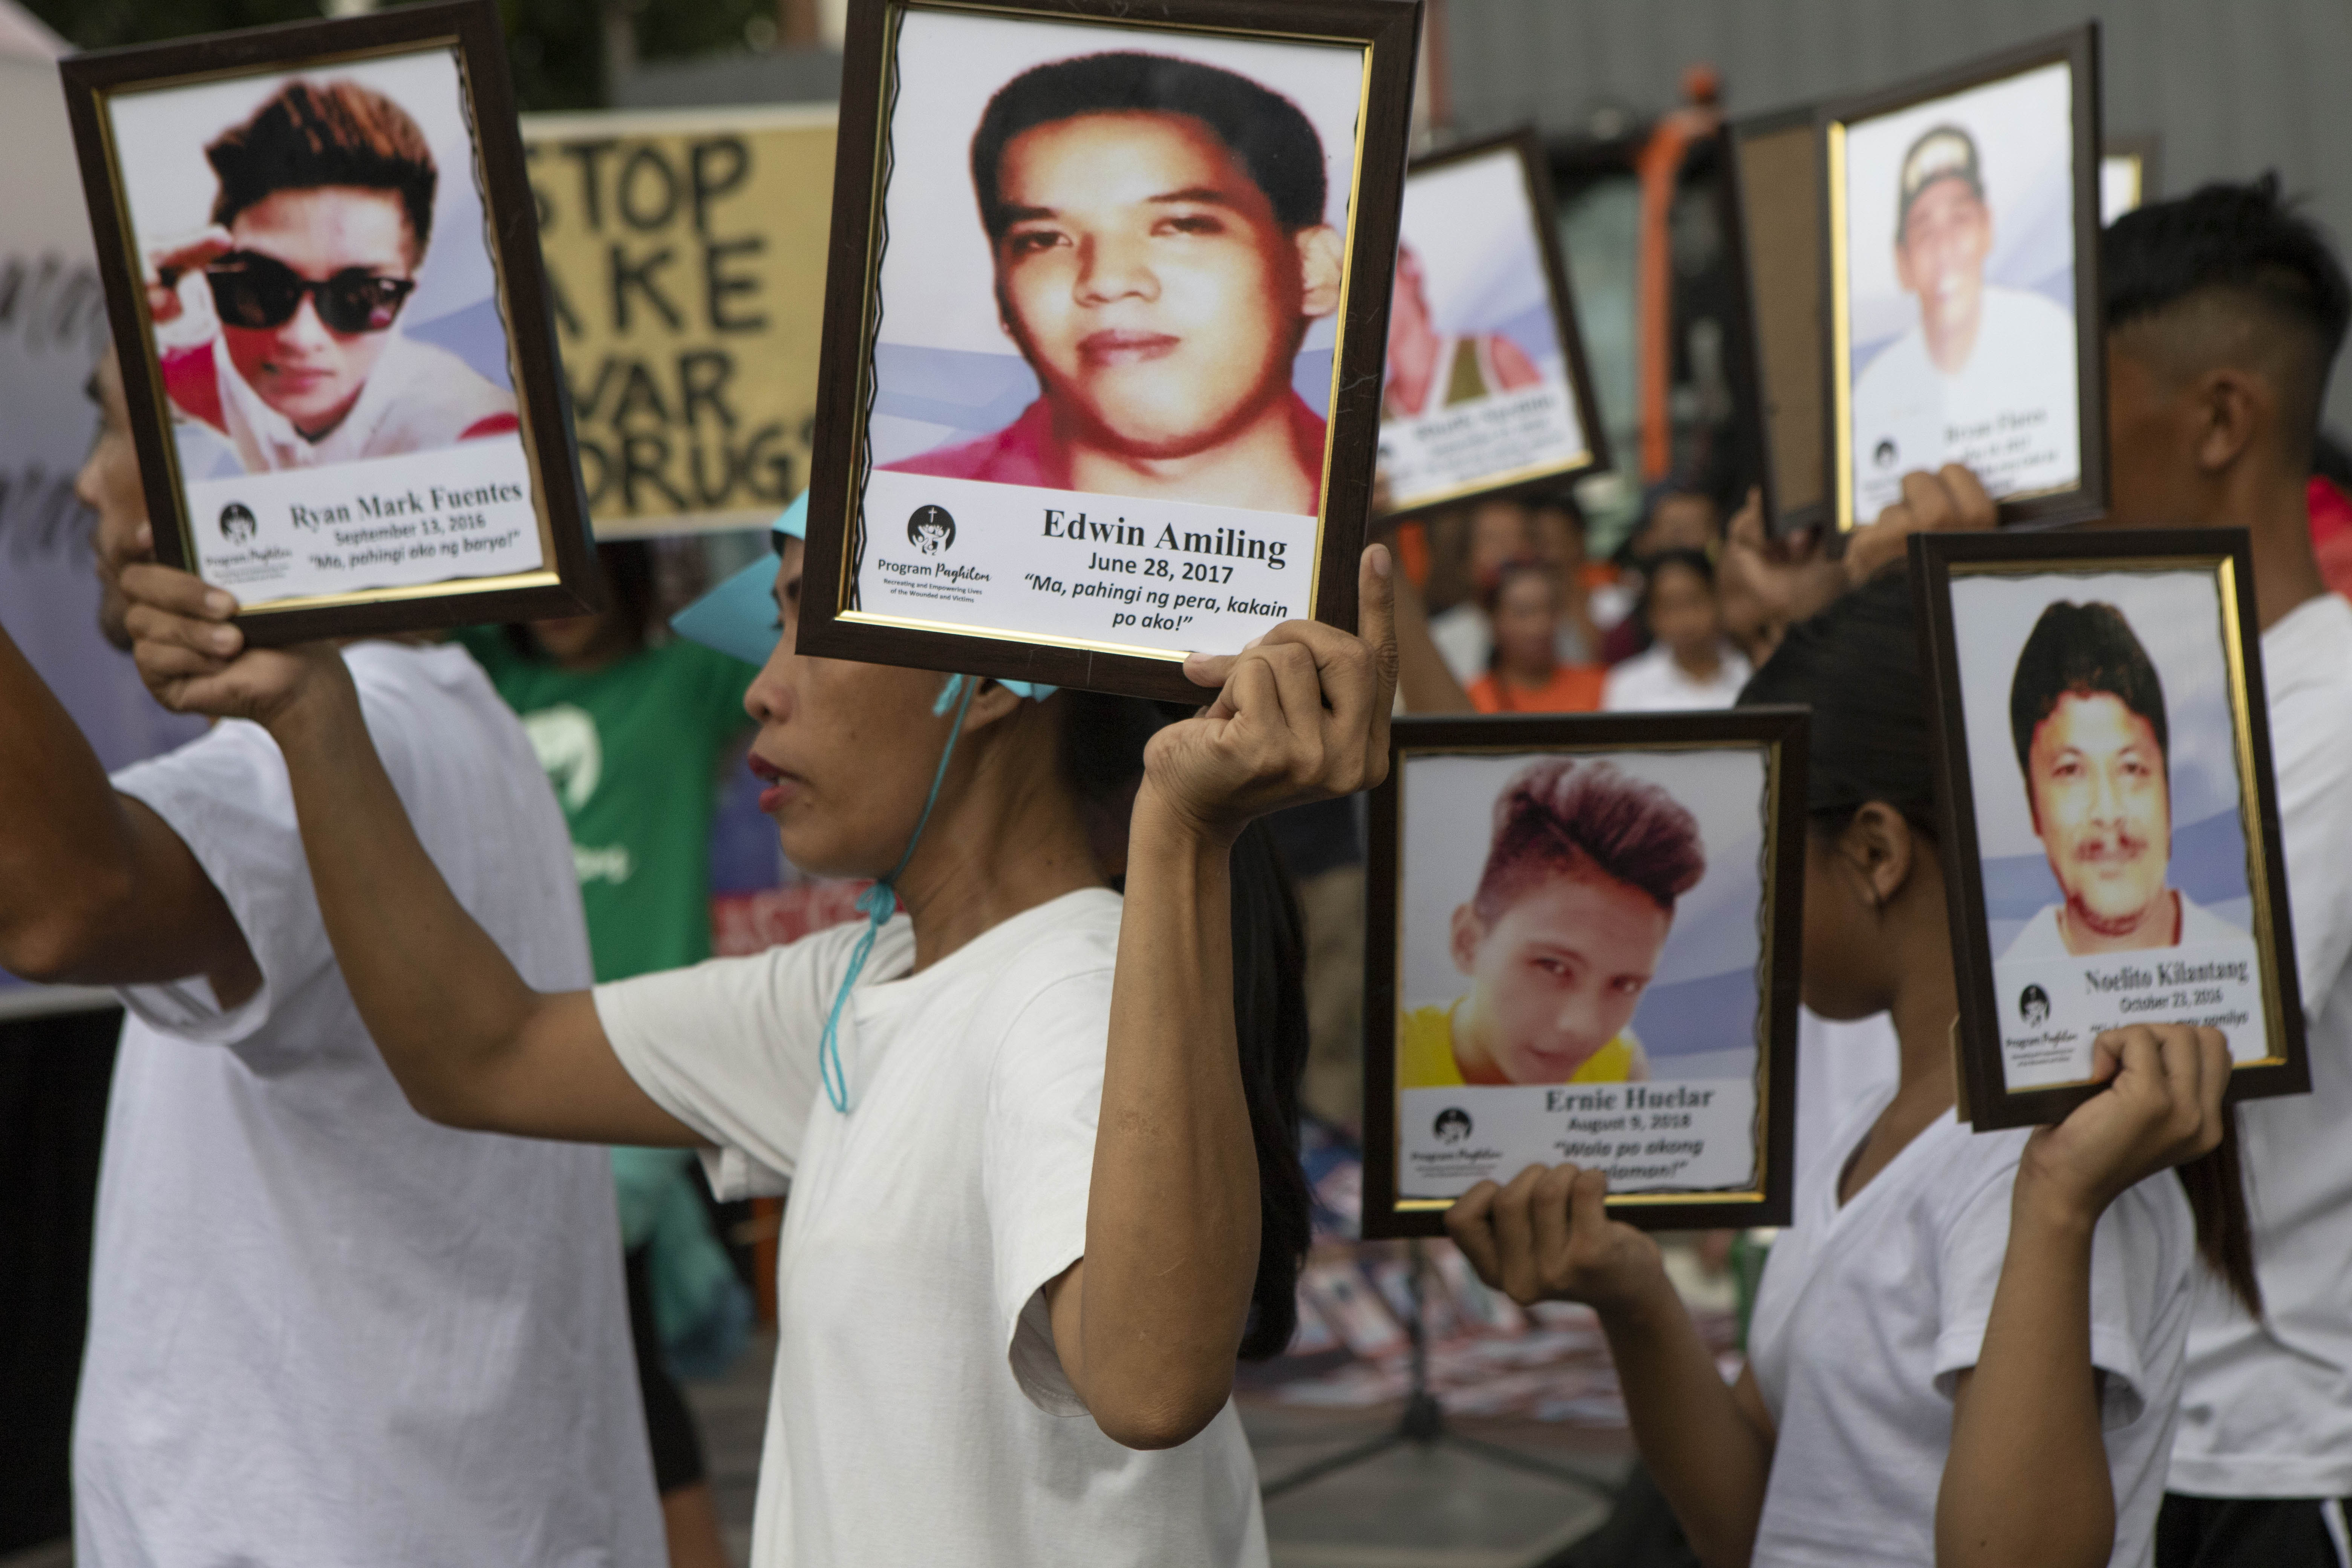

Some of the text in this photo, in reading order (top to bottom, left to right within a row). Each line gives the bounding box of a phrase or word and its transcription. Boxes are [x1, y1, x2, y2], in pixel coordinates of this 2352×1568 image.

[291, 483, 522, 533] Ryan Mark Fuentes
[335, 513, 486, 546] September 13, 2016
[1041, 509, 1287, 570] Edwin Amiling
[349, 545, 405, 569] pahingi
[409, 542, 435, 559] ako
[439, 541, 459, 558] ng
[1089, 552, 1233, 584] June 28, 2017
[878, 559, 991, 583] Program Paghilom
[884, 579, 915, 588] Recreating
[929, 584, 966, 594] Empowering
[910, 590, 938, 599] Wounded
[1025, 573, 1287, 617] “Ma, pahingi ng pera, kakain
[1112, 613, 1193, 631] po ako!”
[2085, 960, 2249, 994] Noelito Kilantang
[2119, 995, 2168, 1013] October
[2194, 987, 2223, 1006] 2016
[1547, 1086, 1715, 1112] Ernie Huelar
[1568, 1116, 1625, 1134] August
[1615, 1142, 1641, 1159] po
[1644, 1137, 1704, 1158] akong
